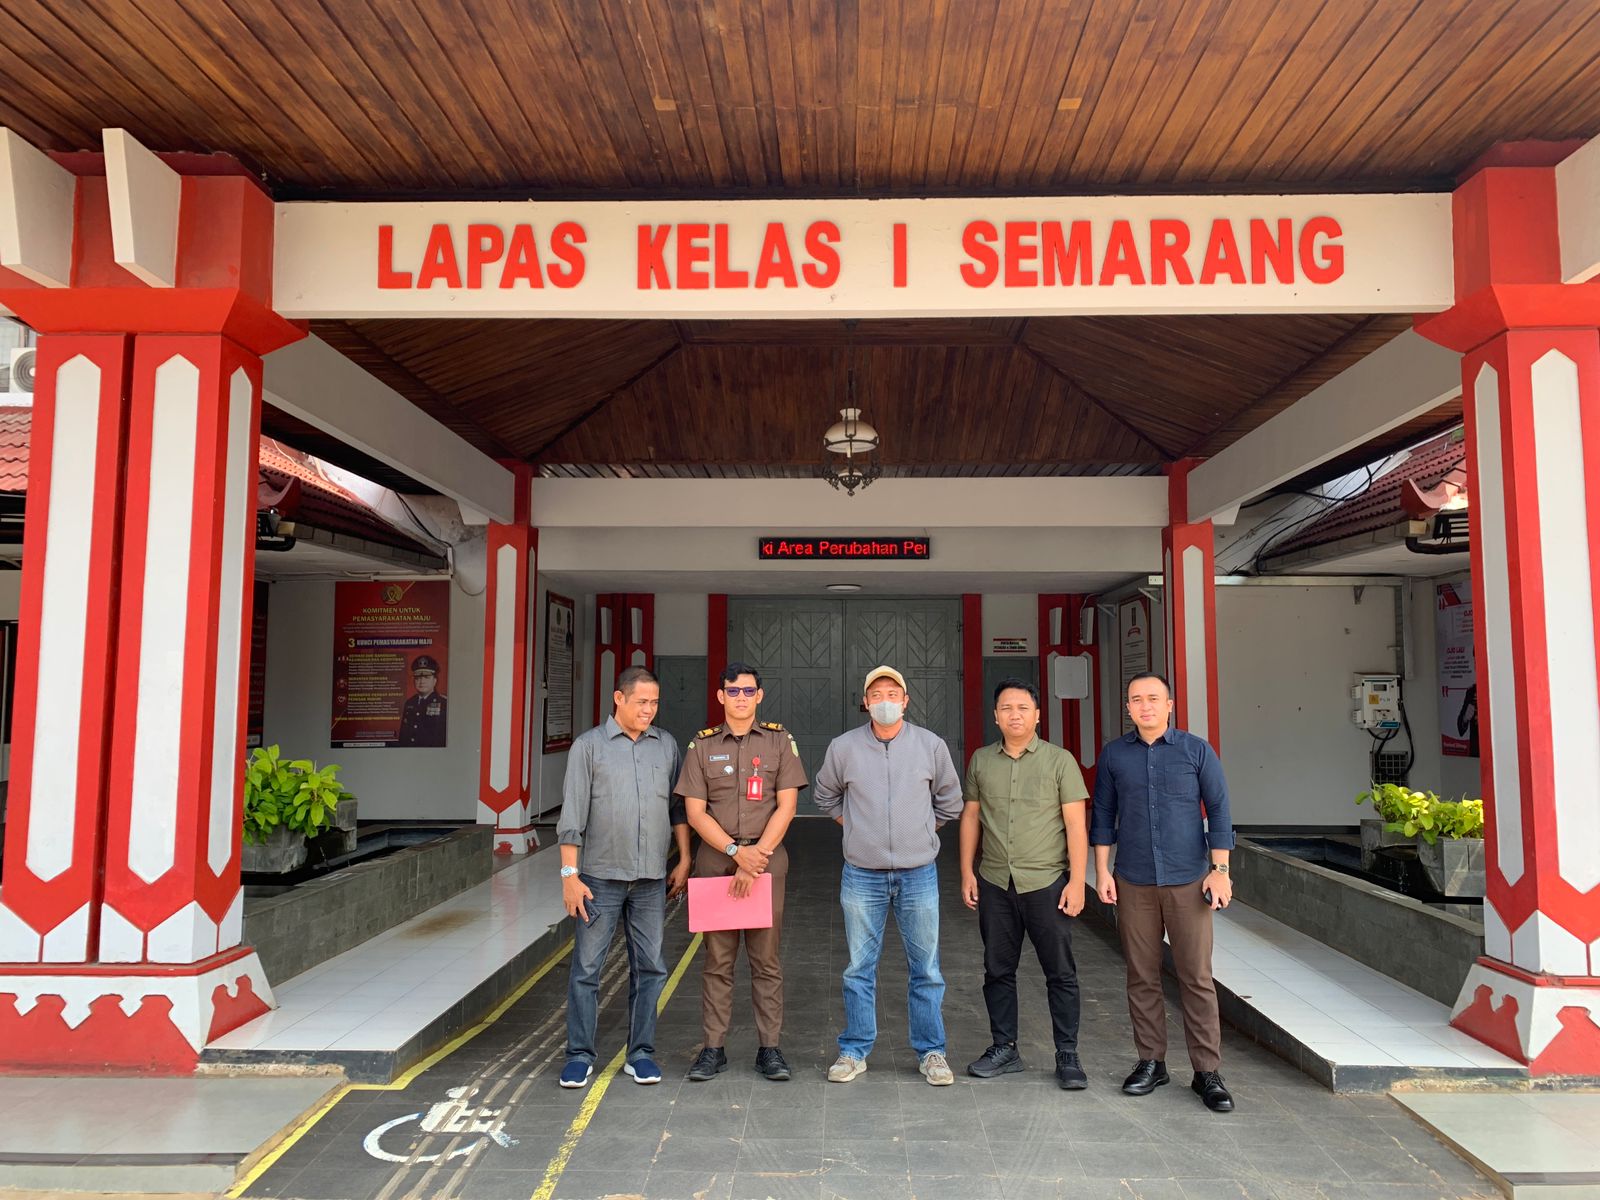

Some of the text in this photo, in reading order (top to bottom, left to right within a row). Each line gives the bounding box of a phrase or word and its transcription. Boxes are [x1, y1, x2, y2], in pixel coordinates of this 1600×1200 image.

[377, 216, 1345, 290] LAPAS KELAS I SEMARANG
[777, 541, 813, 556] Area
[819, 541, 898, 556] Perubahan
[347, 637, 356, 648] 3
